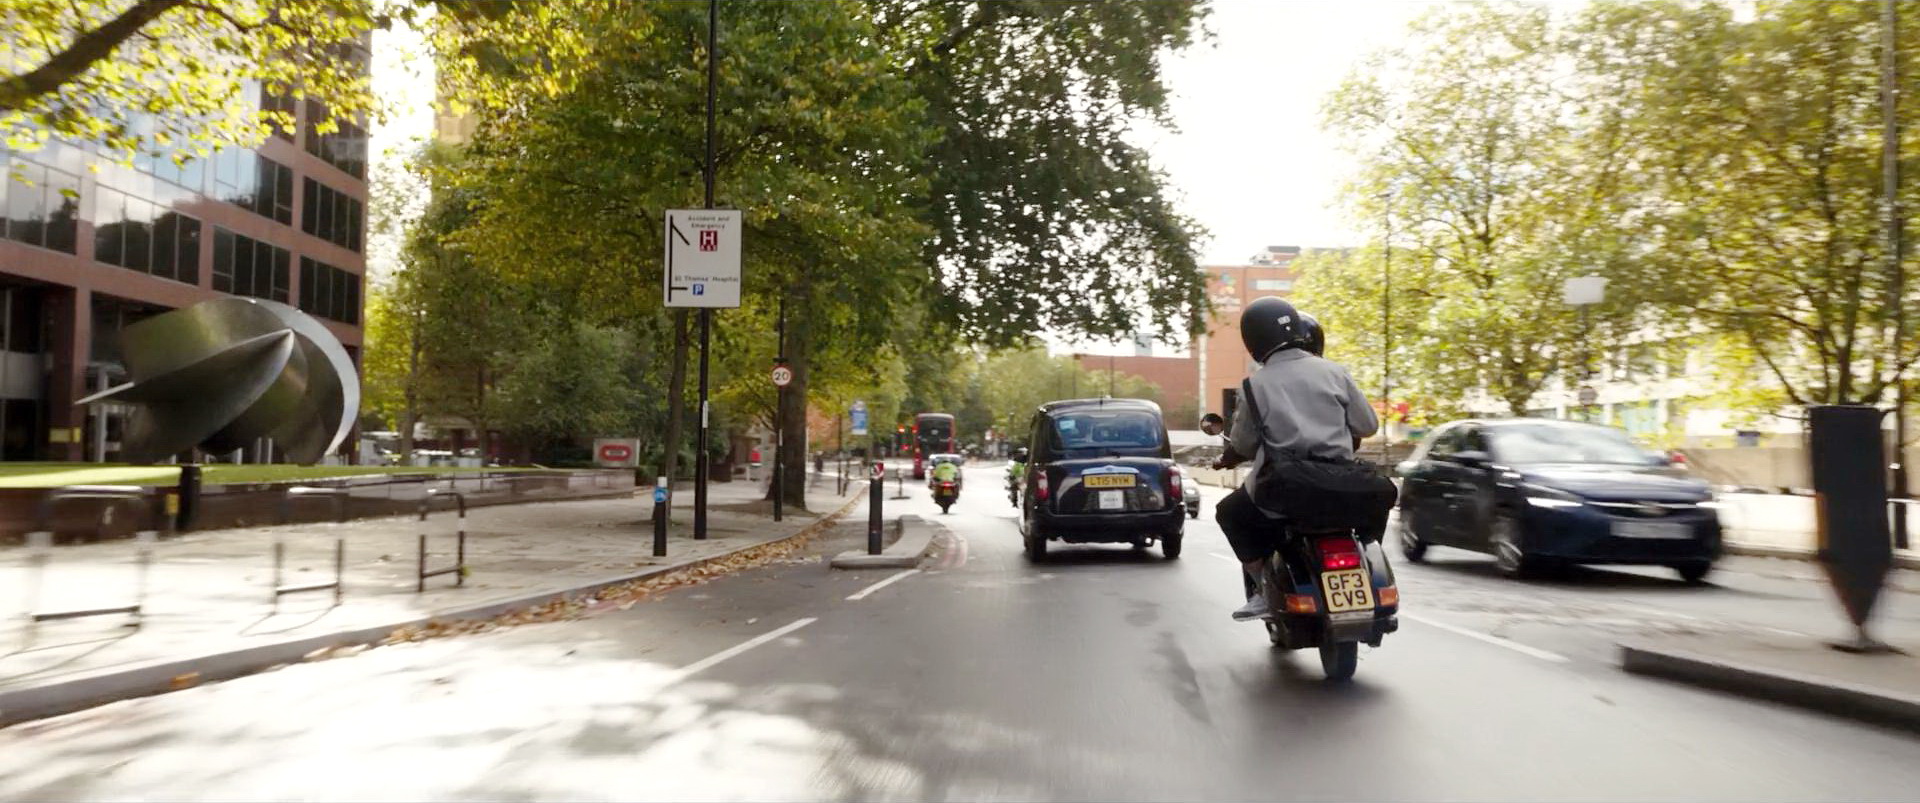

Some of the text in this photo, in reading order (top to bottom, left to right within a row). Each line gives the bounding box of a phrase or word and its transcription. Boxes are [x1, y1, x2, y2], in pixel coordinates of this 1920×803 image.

[703, 232, 714, 245] H
[775, 372, 789, 380] 20
[1328, 573, 1364, 590] GF3
[1332, 590, 1367, 608] CV9
